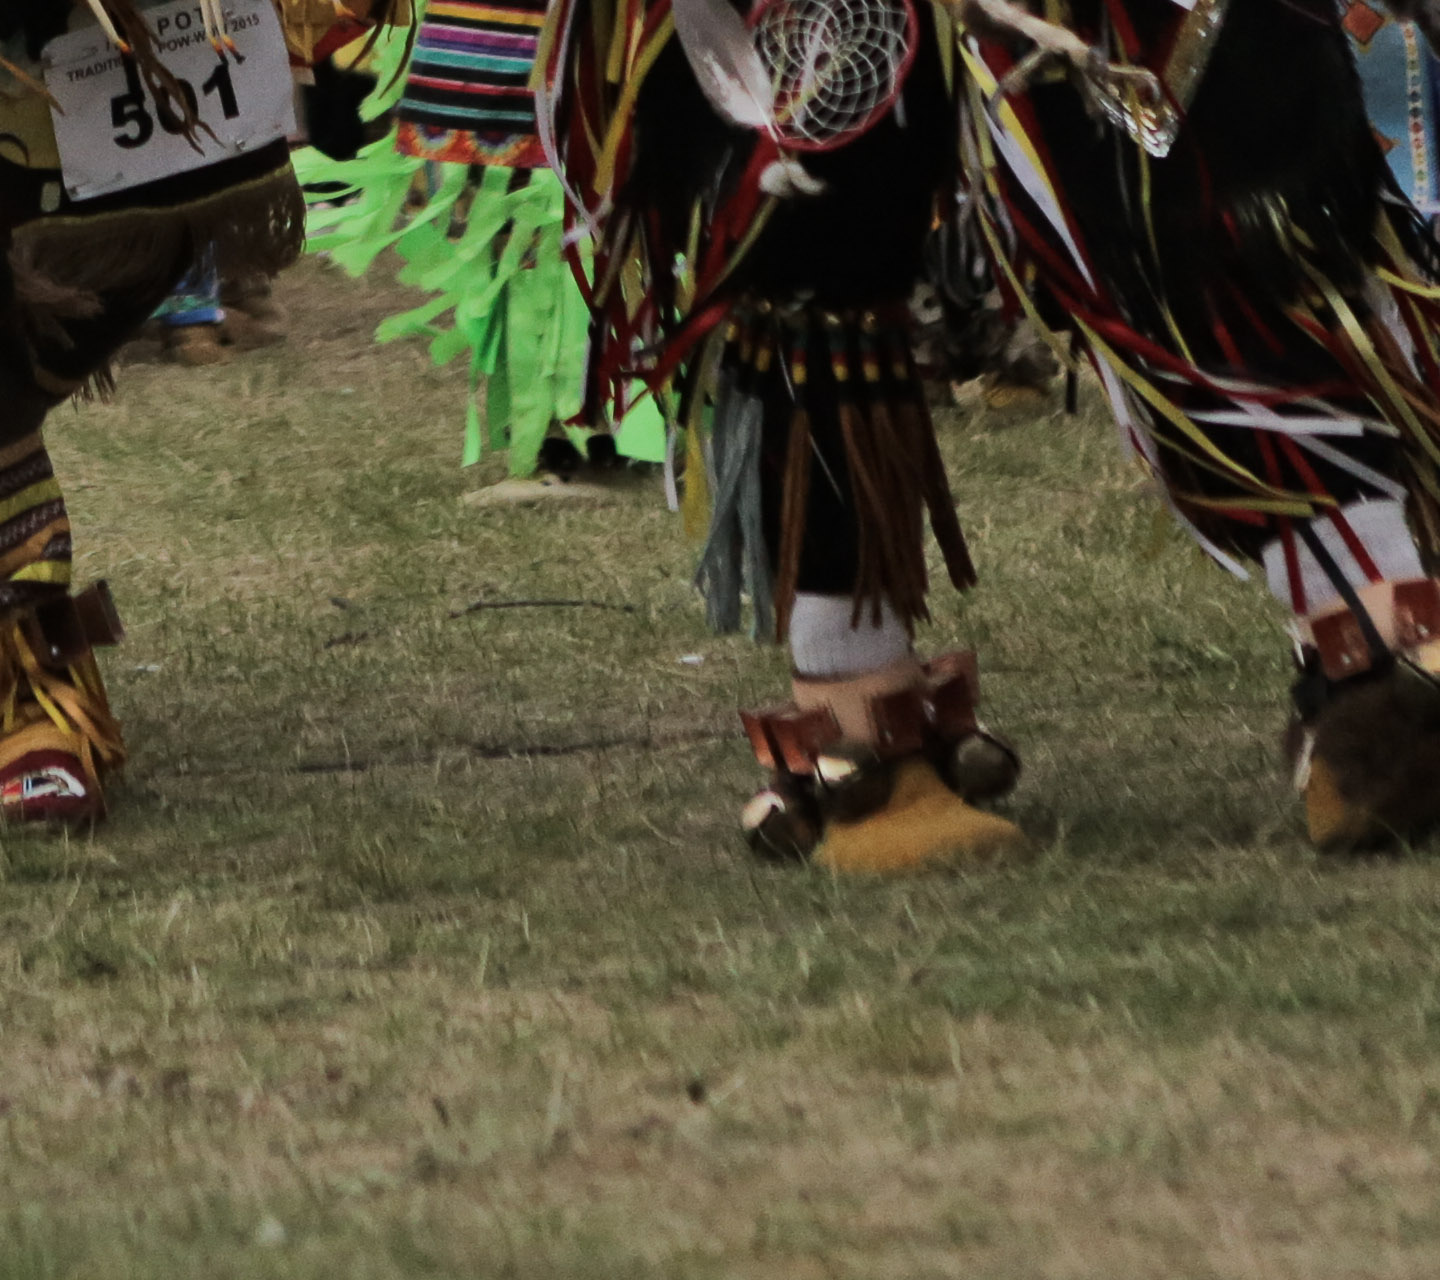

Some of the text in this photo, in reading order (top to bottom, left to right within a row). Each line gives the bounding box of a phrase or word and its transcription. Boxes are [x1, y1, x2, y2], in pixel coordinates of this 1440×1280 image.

[66, 56, 121, 83] TRADITI
[231, 13, 260, 33] 2015
[110, 60, 240, 149] 501
